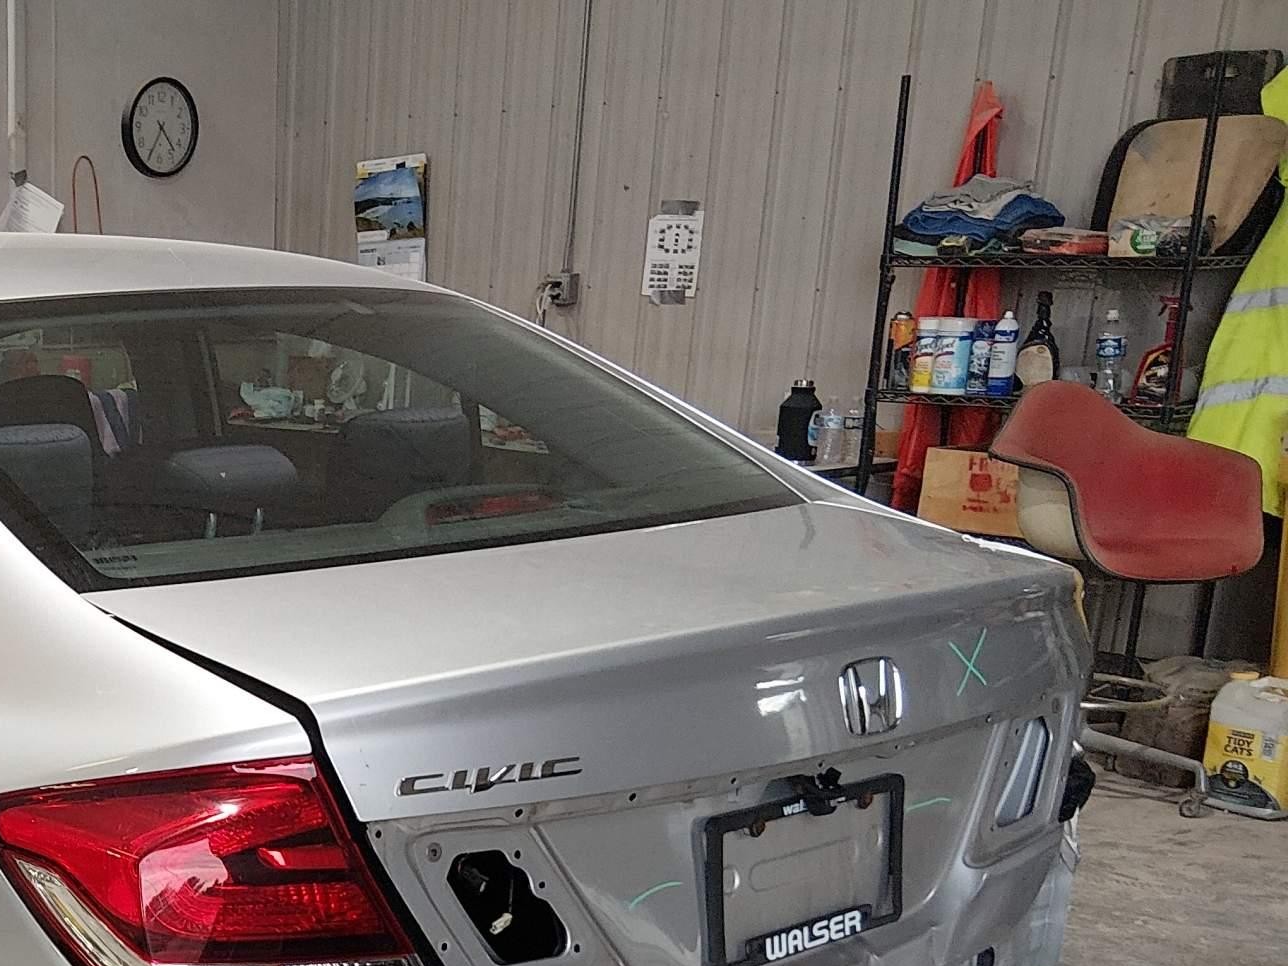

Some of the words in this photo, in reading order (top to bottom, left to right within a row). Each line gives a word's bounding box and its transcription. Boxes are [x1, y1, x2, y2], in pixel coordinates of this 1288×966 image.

[157, 91, 167, 103] 12
[1226, 735, 1253, 748] TIDY
[1223, 744, 1254, 757] CATS
[394, 756, 583, 797] CIVIC
[765, 909, 862, 961] WALSER
